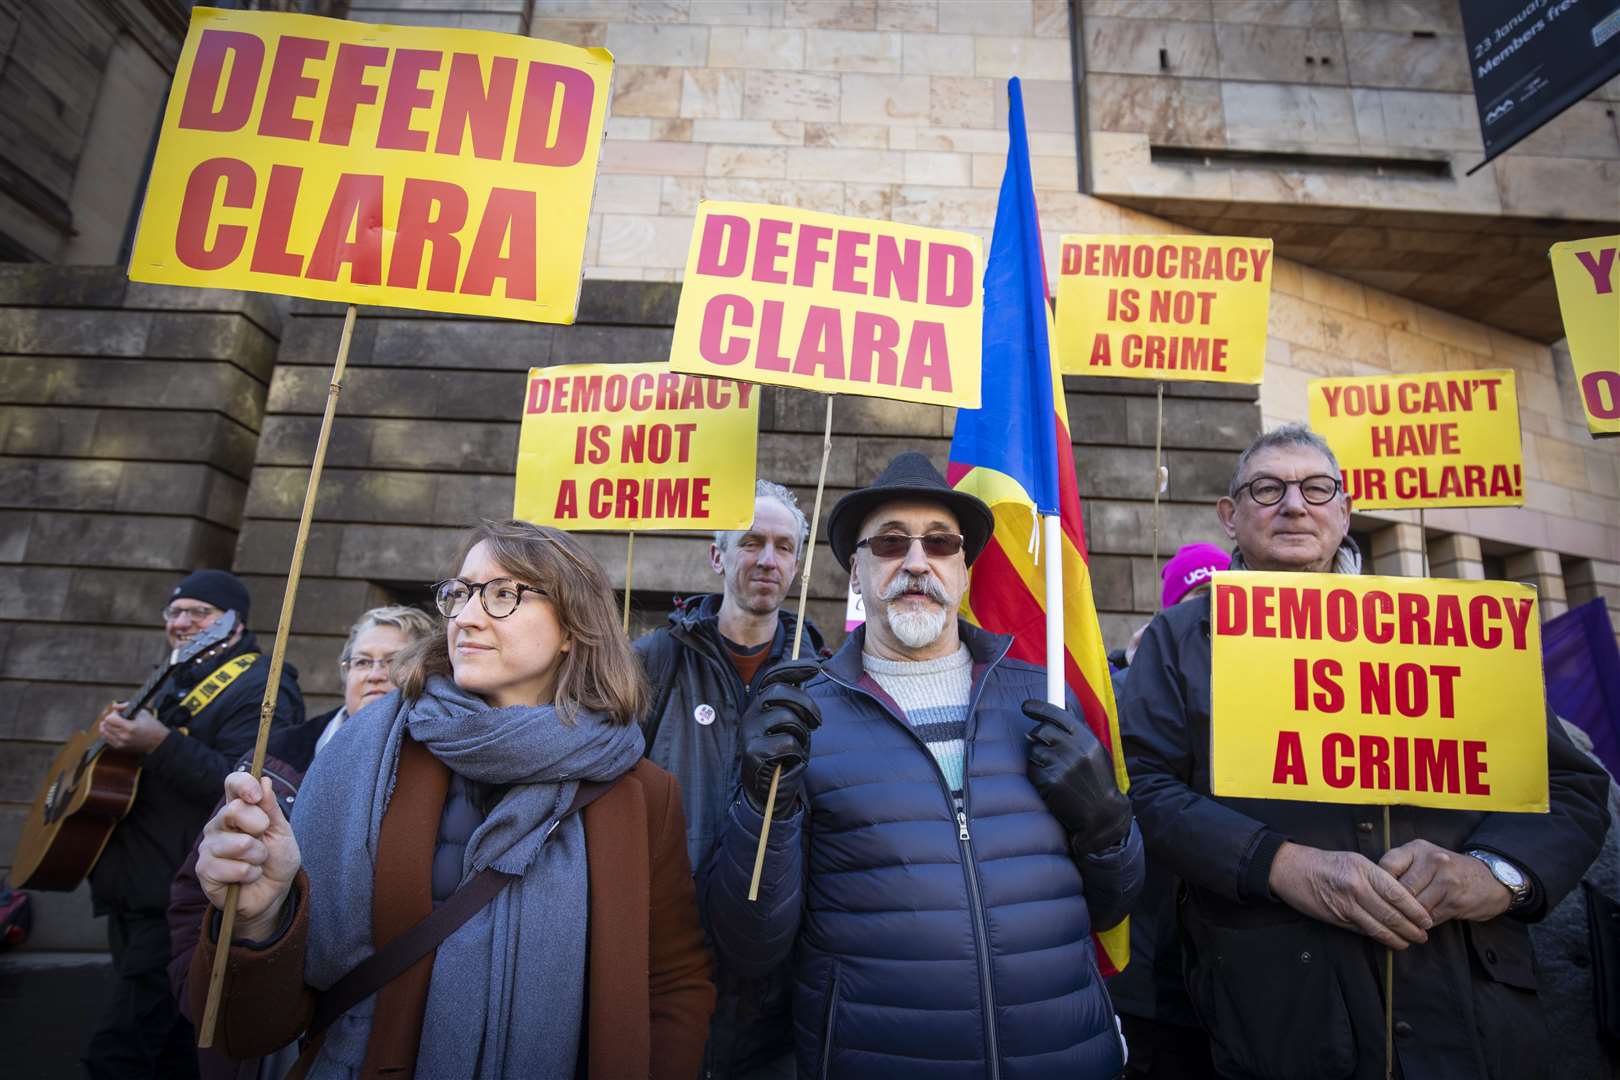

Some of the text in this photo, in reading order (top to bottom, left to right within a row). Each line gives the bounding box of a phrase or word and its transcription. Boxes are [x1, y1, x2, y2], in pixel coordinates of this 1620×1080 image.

[1474, 37, 1492, 58] 23
[1478, 0, 1579, 78] Members fre
[179, 30, 595, 167] DEFEND
[175, 157, 537, 302] CLARA
[696, 213, 974, 308] DEFEND
[1061, 243, 1271, 283] DEMOCRACY
[1575, 248, 1620, 294] Y
[1107, 288, 1217, 325] IS NOT
[699, 293, 953, 393] CLARA
[1089, 333, 1229, 373] A CRIME
[526, 373, 754, 414] DEMOCRACY
[1321, 379, 1502, 417] YOU CAN'T
[574, 423, 697, 464] IS NOT
[1371, 423, 1461, 457] HAVE
[554, 477, 711, 519] A CRIME
[1340, 464, 1521, 501] UR CLARA!
[1216, 584, 1534, 651] DEMOCRACY
[1293, 658, 1462, 719] IS NOT
[1272, 730, 1491, 796] A CRIME
